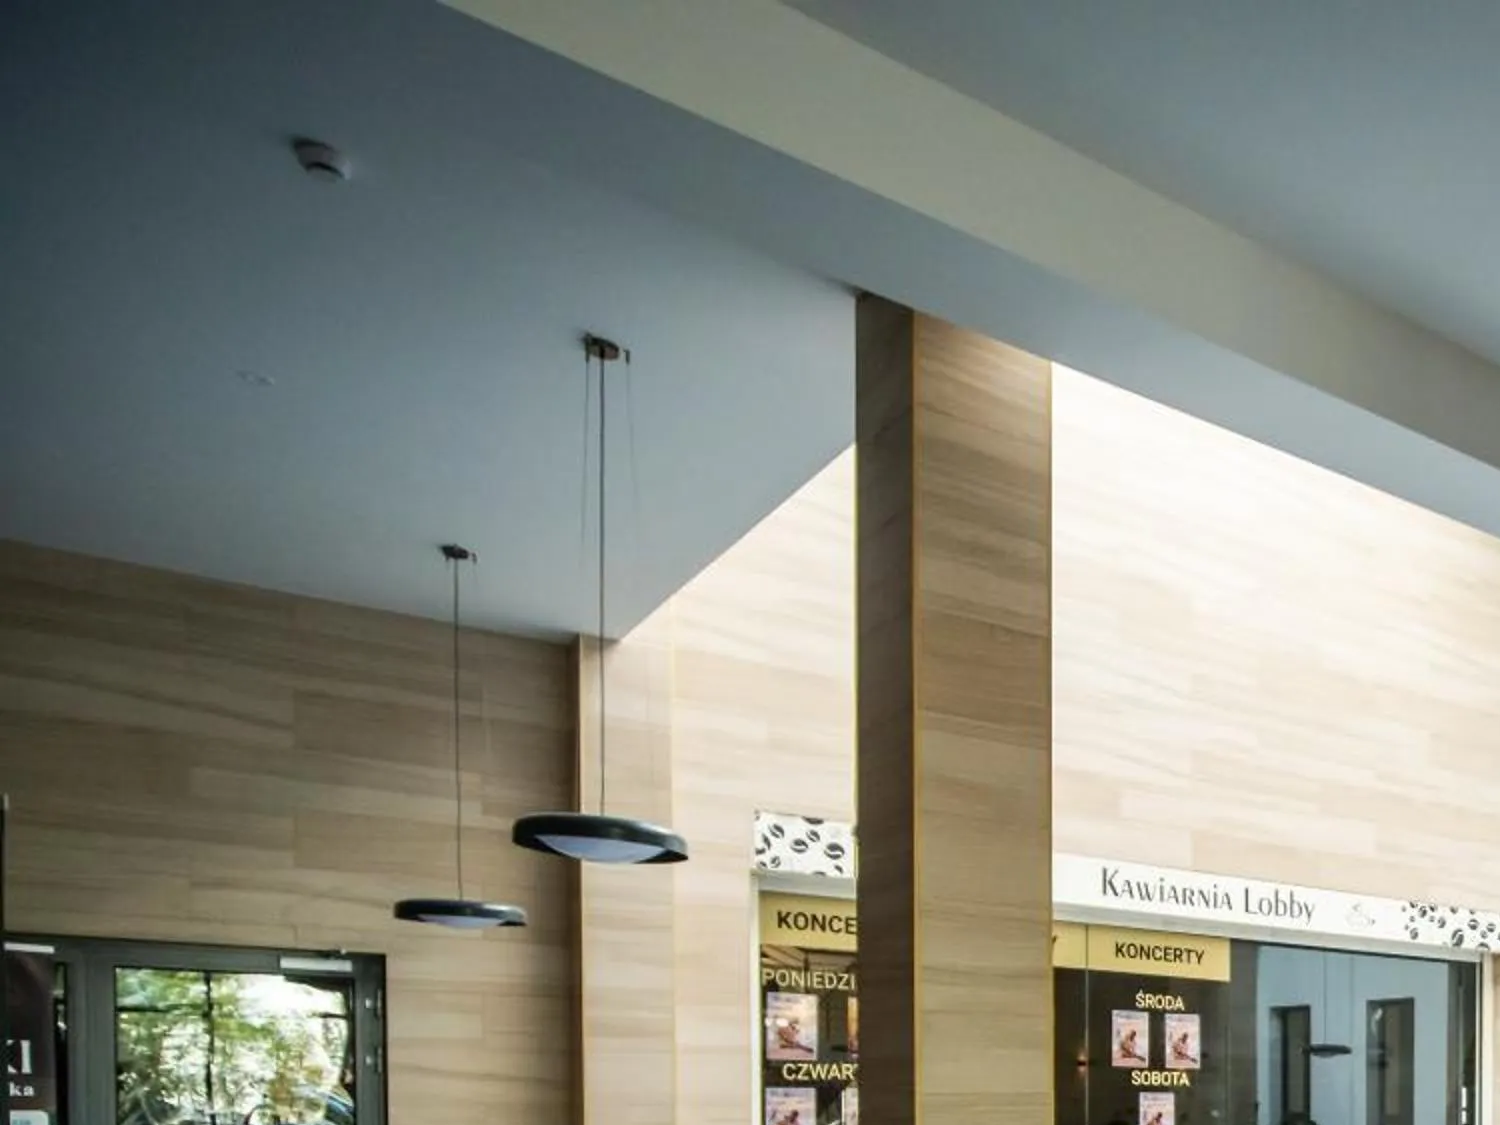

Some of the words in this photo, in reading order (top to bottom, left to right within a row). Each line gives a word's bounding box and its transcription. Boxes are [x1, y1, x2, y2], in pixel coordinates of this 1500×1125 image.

[1244, 887, 1315, 926] Lobby
[1115, 941, 1205, 965] KONCERTY
[1135, 989, 1185, 1011] ŚRODA
[782, 1062, 859, 1081] CZWAR
[1131, 1070, 1190, 1087] SOBOTA
